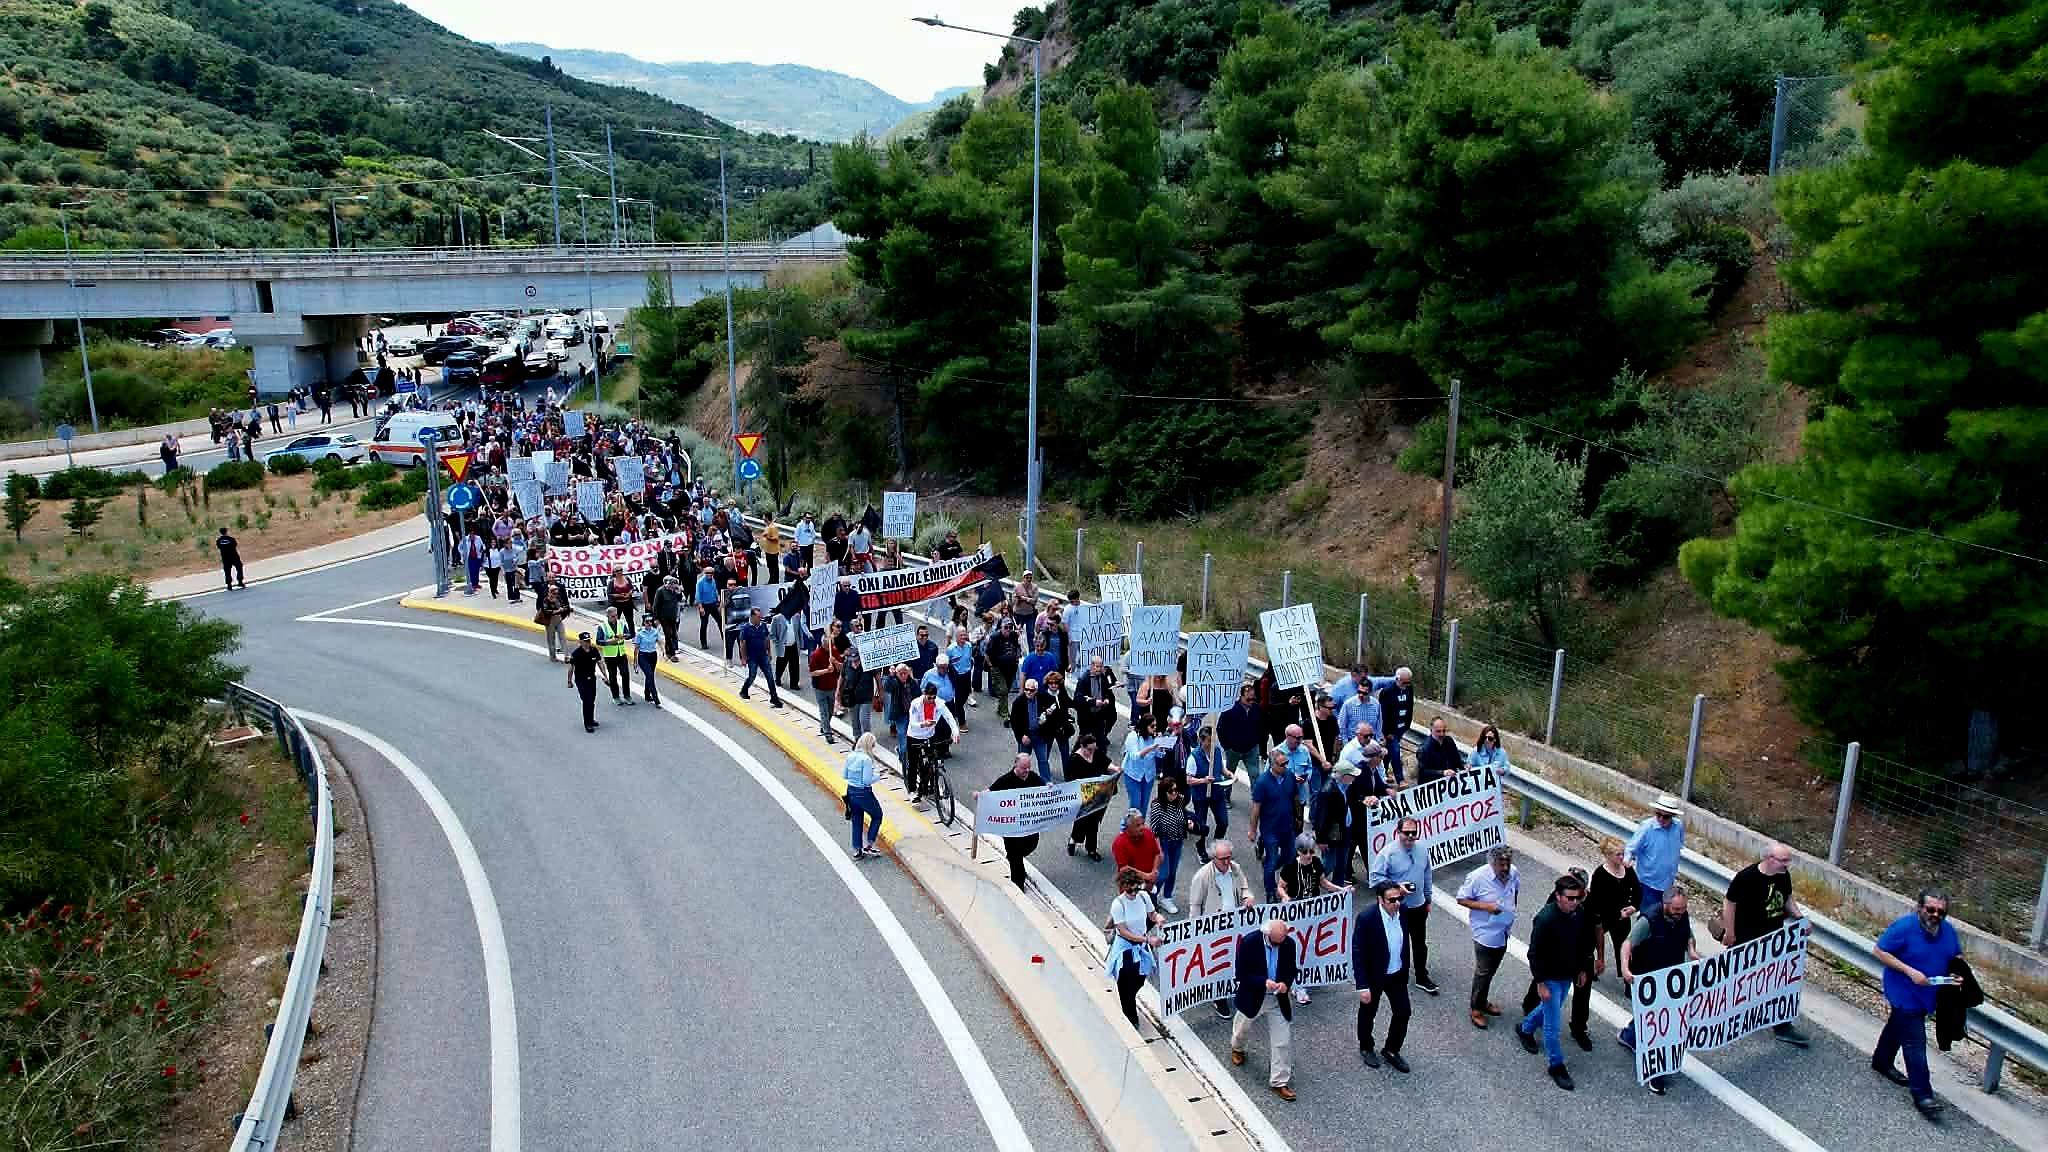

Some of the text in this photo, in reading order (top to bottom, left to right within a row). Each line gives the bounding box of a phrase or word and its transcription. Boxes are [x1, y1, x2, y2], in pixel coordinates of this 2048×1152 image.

[600, 535, 685, 560] ΧΡΟΝΑ
[859, 577, 879, 592] ΟΧΙ
[883, 572, 922, 590] ΑΛΛΟΣ
[1105, 575, 1139, 592] ΛΥΣΗ
[1143, 609, 1170, 626] ΟΧΙ
[1269, 607, 1311, 631] ΛΥΣΗ
[1081, 622, 1120, 645] ΑΛΛΟΣ
[1192, 633, 1245, 650] ΛΥΣΗ
[1198, 653, 1232, 667] ΤΩΡΑ
[1192, 669, 1215, 683] ΓΙΑ
[1000, 799, 1016, 808] ΟΧΙ
[1370, 767, 1497, 827] ΞΑΝΑ ΜΠΡΟΣΤΑ
[987, 815, 1016, 824] ΑΜΕΣΗ
[1373, 796, 1499, 855] Ο ΟΝΤΩΤΟΣ
[1427, 825, 1502, 867] ΚΑΤΑΛΕΙΨΗ ΠΙΑ
[1163, 892, 1348, 945] ΣΤΙΣ ΡΑΓΕΣ ΤΟΥ ΟΔΟΝΤΩΤΟΥ
[1164, 916, 1348, 989] ΤΑΞΙΥΕΙ
[1165, 1000, 1172, 1015] Η
[1174, 983, 1213, 1011] ΜΝΗΜΗ
[1216, 977, 1241, 997] ΜΑΣ
[1325, 963, 1348, 984] ΜΑΣ
[1638, 975, 1657, 1006] Ο
[1640, 955, 1801, 1046] 130 ΧΟΝΙΑ ΙΣΤΟΡΙΑΣ
[1642, 1045, 1666, 1078] ΔΕΝ
[1727, 1015, 1740, 1040] ΣΕ
